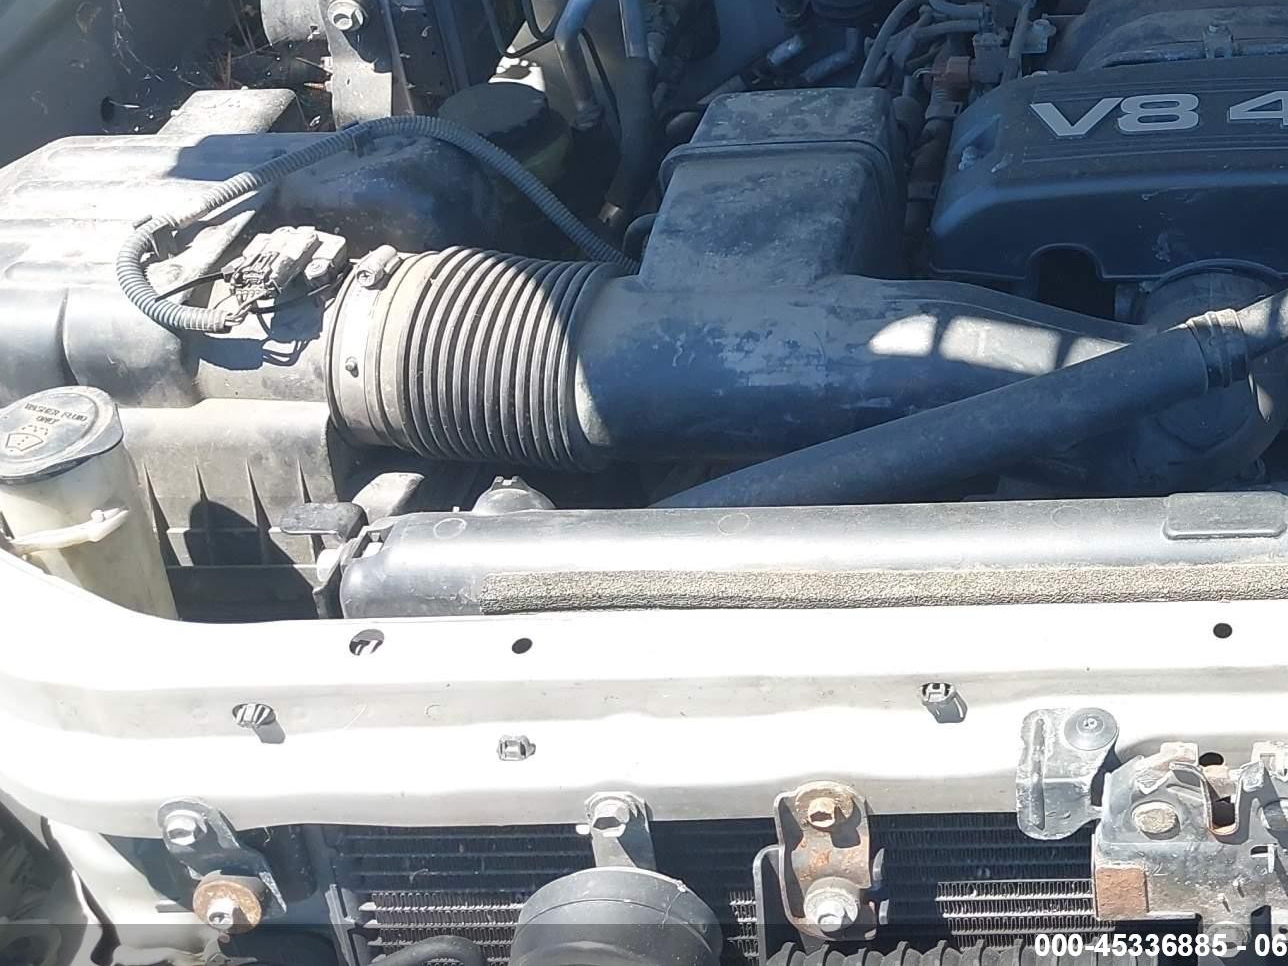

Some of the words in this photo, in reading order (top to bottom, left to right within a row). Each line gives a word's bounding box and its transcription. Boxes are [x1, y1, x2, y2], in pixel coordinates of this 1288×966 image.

[1030, 93, 1199, 137] V8
[24, 403, 60, 416] WASHER
[60, 410, 89, 422] FLUID
[35, 415, 61, 425] ONLY
